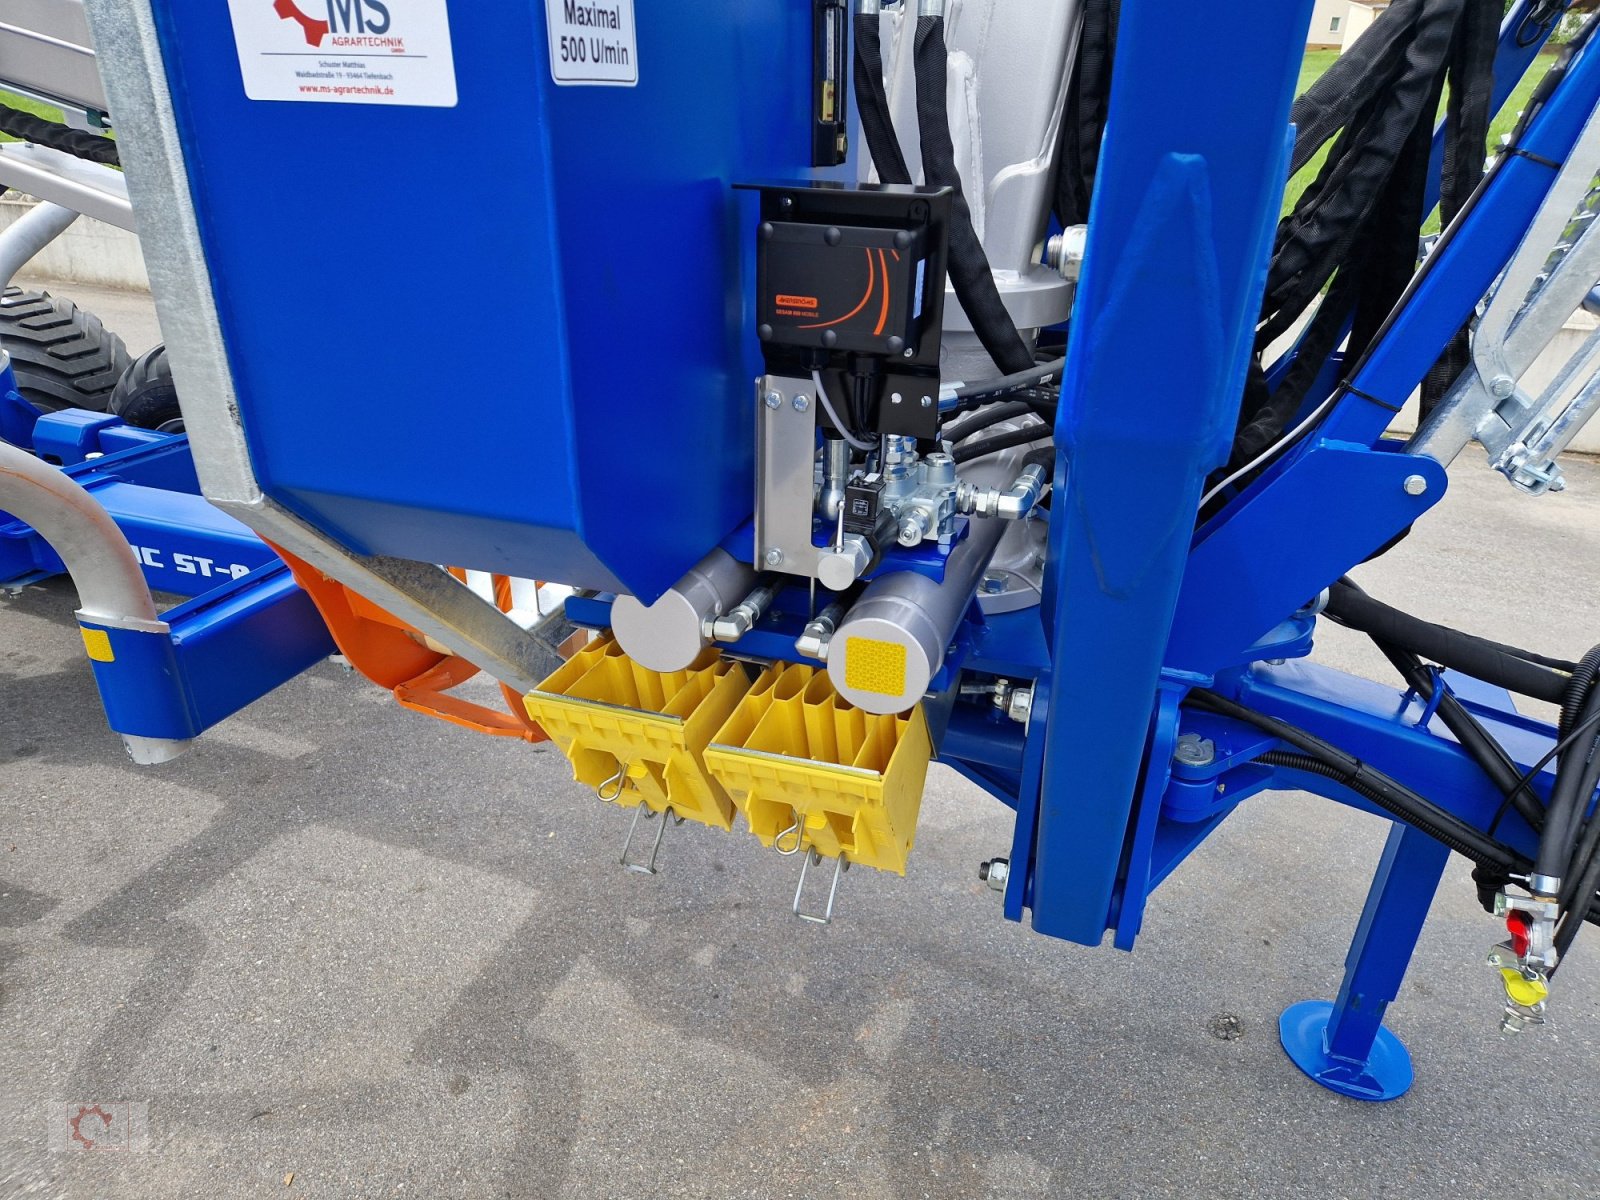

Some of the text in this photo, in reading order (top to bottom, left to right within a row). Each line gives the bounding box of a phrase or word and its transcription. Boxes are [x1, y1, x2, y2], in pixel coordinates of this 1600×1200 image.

[326, 0, 391, 35] MS
[564, 0, 621, 30] Maximal
[332, 37, 404, 47] AGRARTECHNIK
[561, 36, 629, 65] 500 U/min
[299, 86, 394, 95] www.ms-agrartechnik.de
